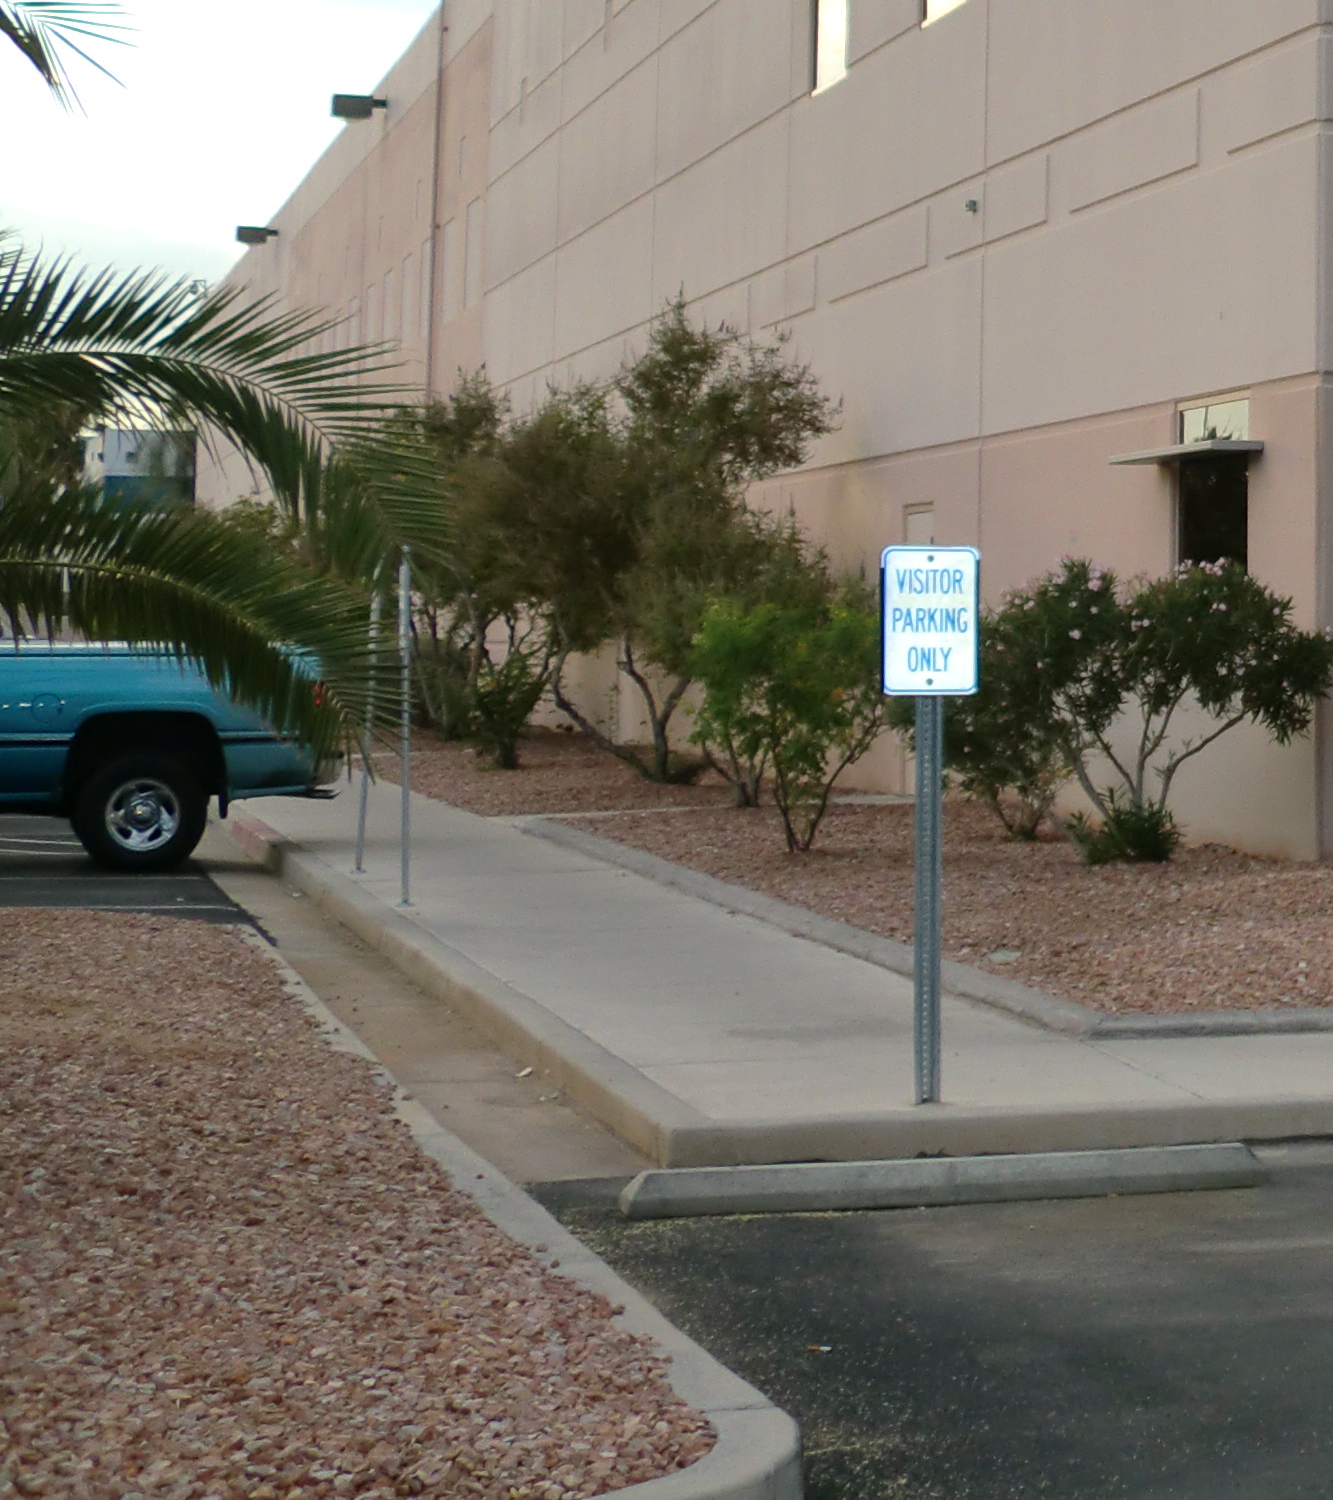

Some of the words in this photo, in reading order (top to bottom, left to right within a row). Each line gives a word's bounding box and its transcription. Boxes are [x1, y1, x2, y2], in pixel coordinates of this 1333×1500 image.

[896, 568, 964, 594] VISITOR
[892, 607, 968, 633] PARKING
[907, 646, 952, 672] ONLY
